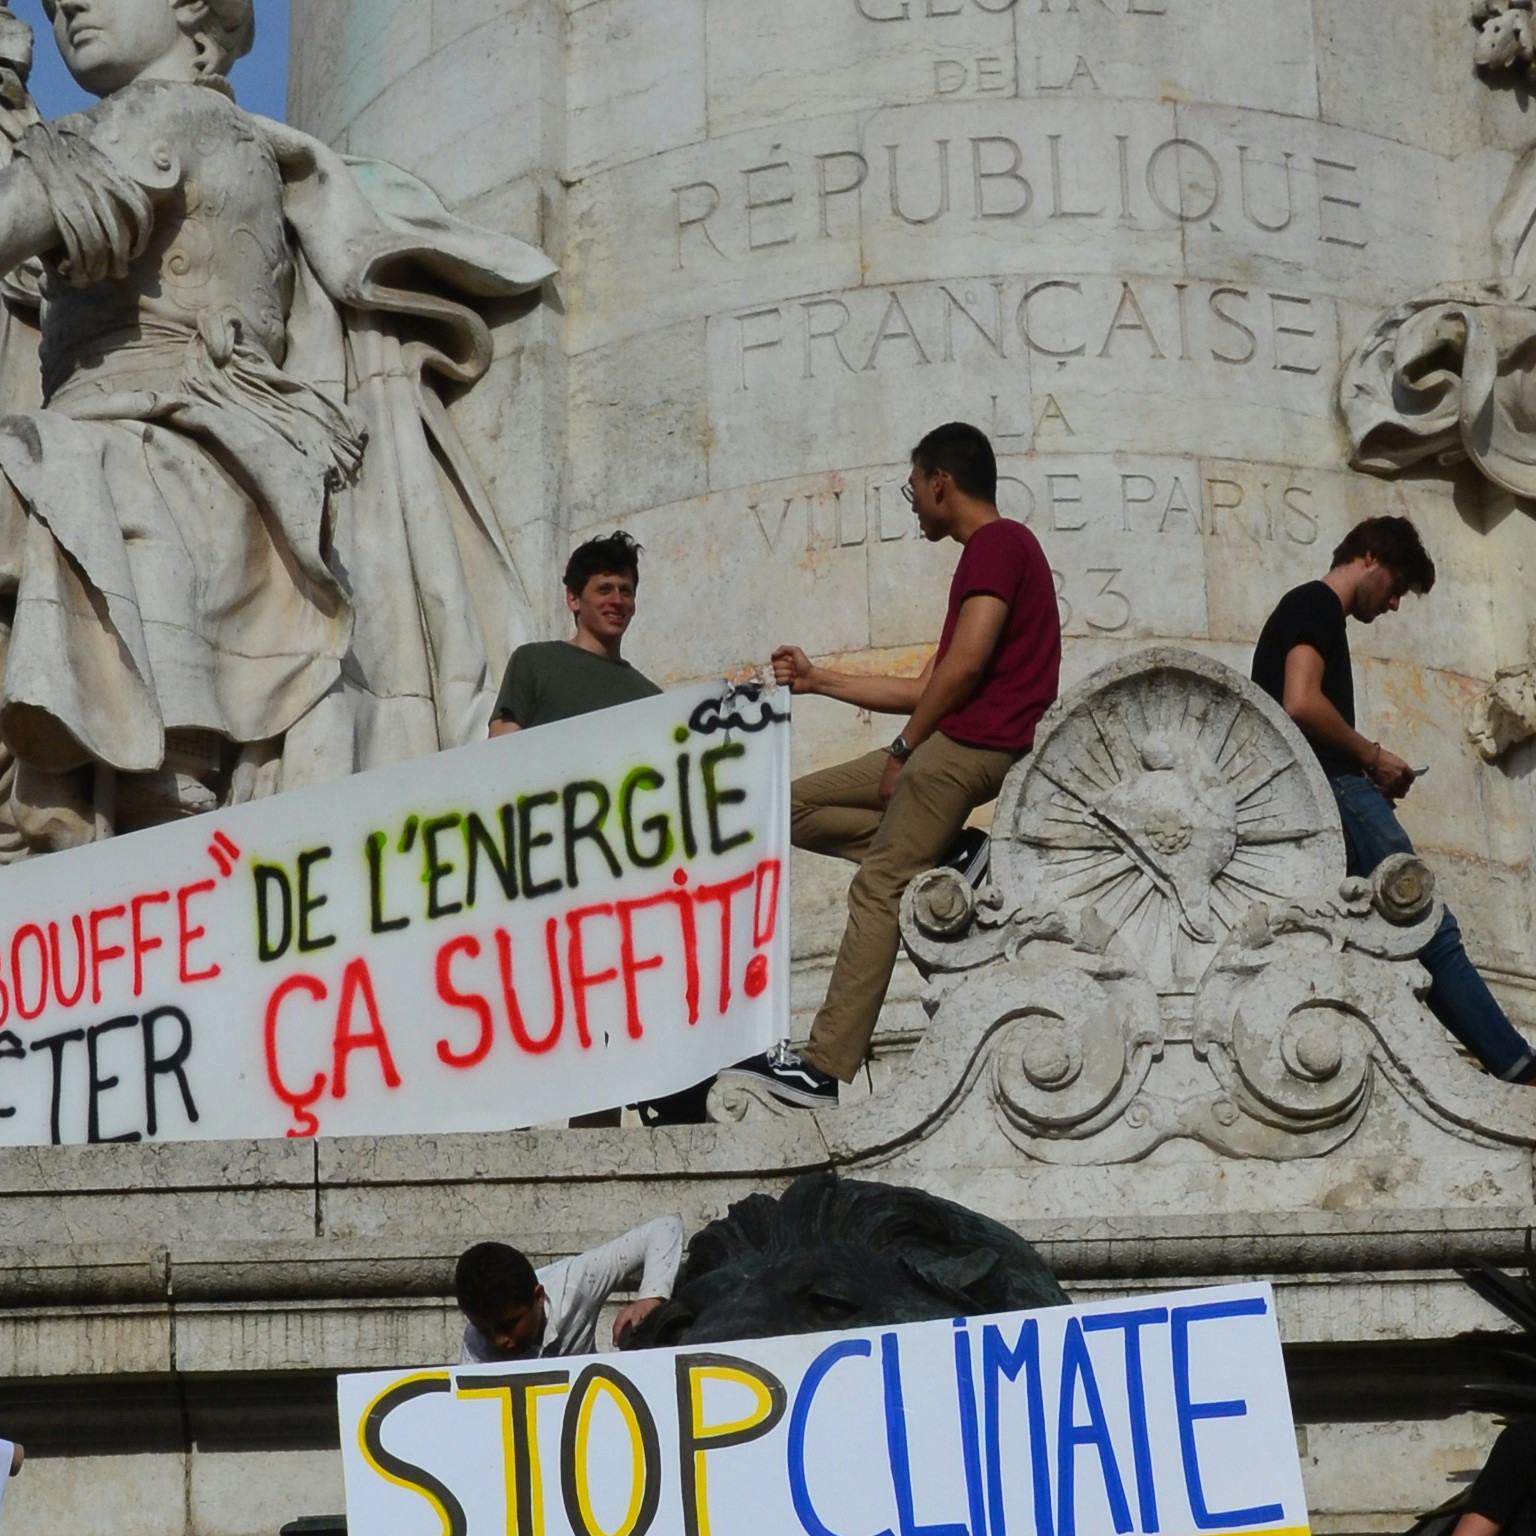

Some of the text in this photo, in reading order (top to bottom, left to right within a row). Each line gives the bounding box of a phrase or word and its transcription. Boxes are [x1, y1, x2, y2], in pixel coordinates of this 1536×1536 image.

[933, 55, 1100, 94] DE LA
[670, 133, 1369, 270] RÉPUBLIQUE
[735, 279, 1322, 393] FRANÇAISE
[988, 393, 1076, 438] LA
[747, 476, 924, 551] VILL
[1120, 473, 1319, 546] PARIS
[251, 846, 336, 963] DE
[264, 957, 402, 1139] ÇA
